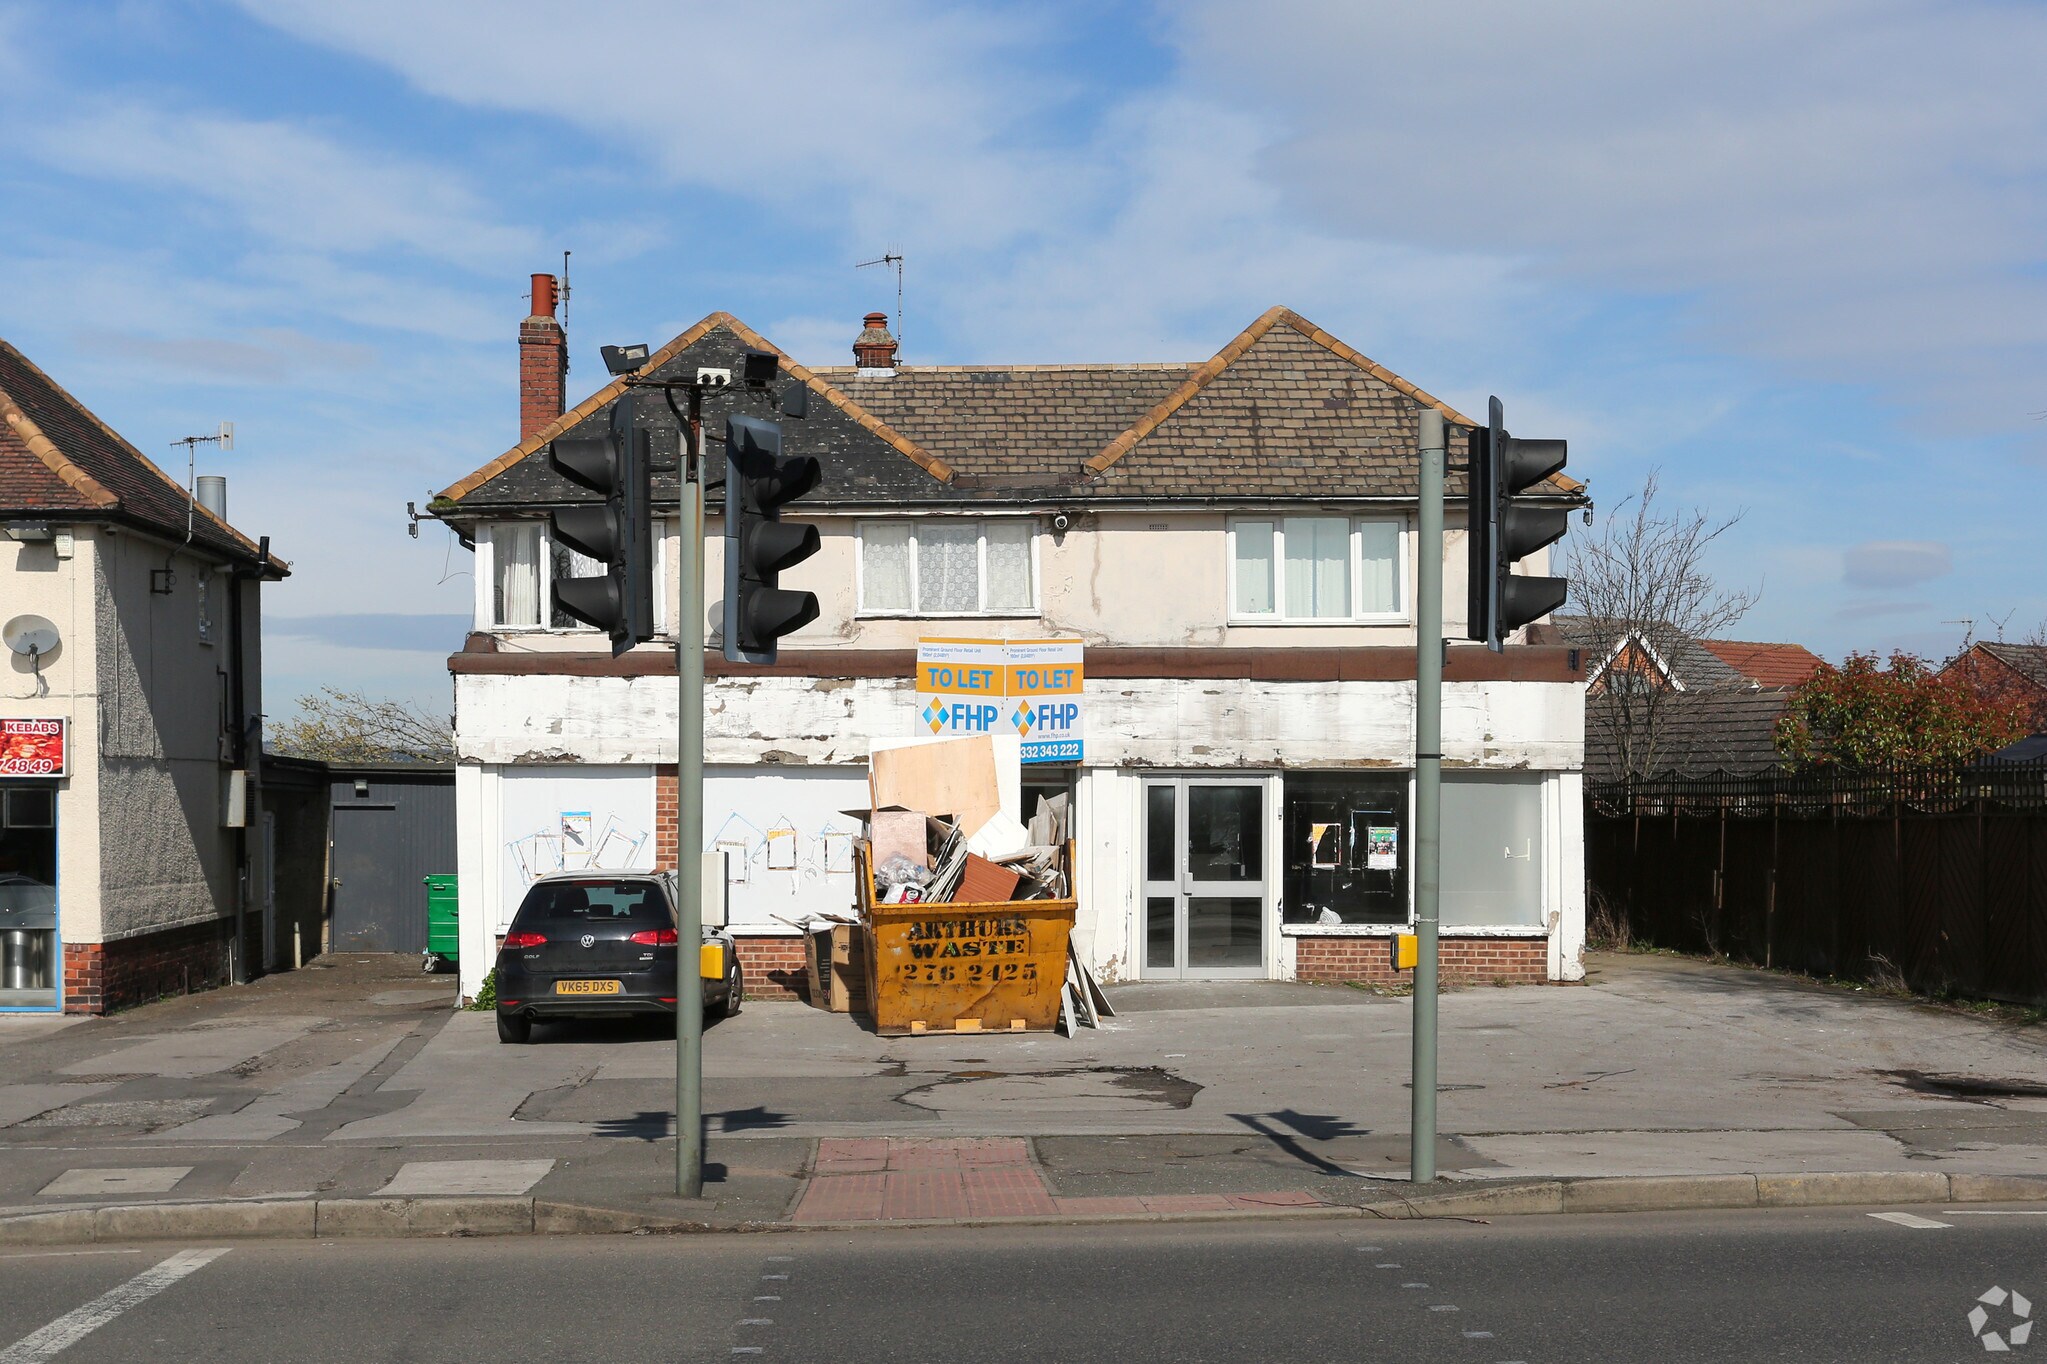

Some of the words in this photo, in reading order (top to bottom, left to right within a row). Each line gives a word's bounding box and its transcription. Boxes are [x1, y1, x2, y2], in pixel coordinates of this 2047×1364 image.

[928, 668, 953, 688] TO
[957, 669, 993, 689] LET
[1016, 669, 1039, 689] TO
[1043, 669, 1074, 689] LET
[951, 703, 998, 732] FHP
[1037, 703, 1079, 731] FHP
[6, 722, 59, 734] KEBABS
[1037, 732, 1071, 740] www.fhp.co.uk
[1040, 744, 1058, 757] 343
[1060, 743, 1079, 756] 222
[907, 918, 1027, 940] ARTHURS
[908, 940, 1025, 959] WASTE
[904, 963, 955, 981] 276
[968, 963, 1037, 981] 2425
[561, 981, 590, 992] VK65
[592, 981, 614, 992] DXS
